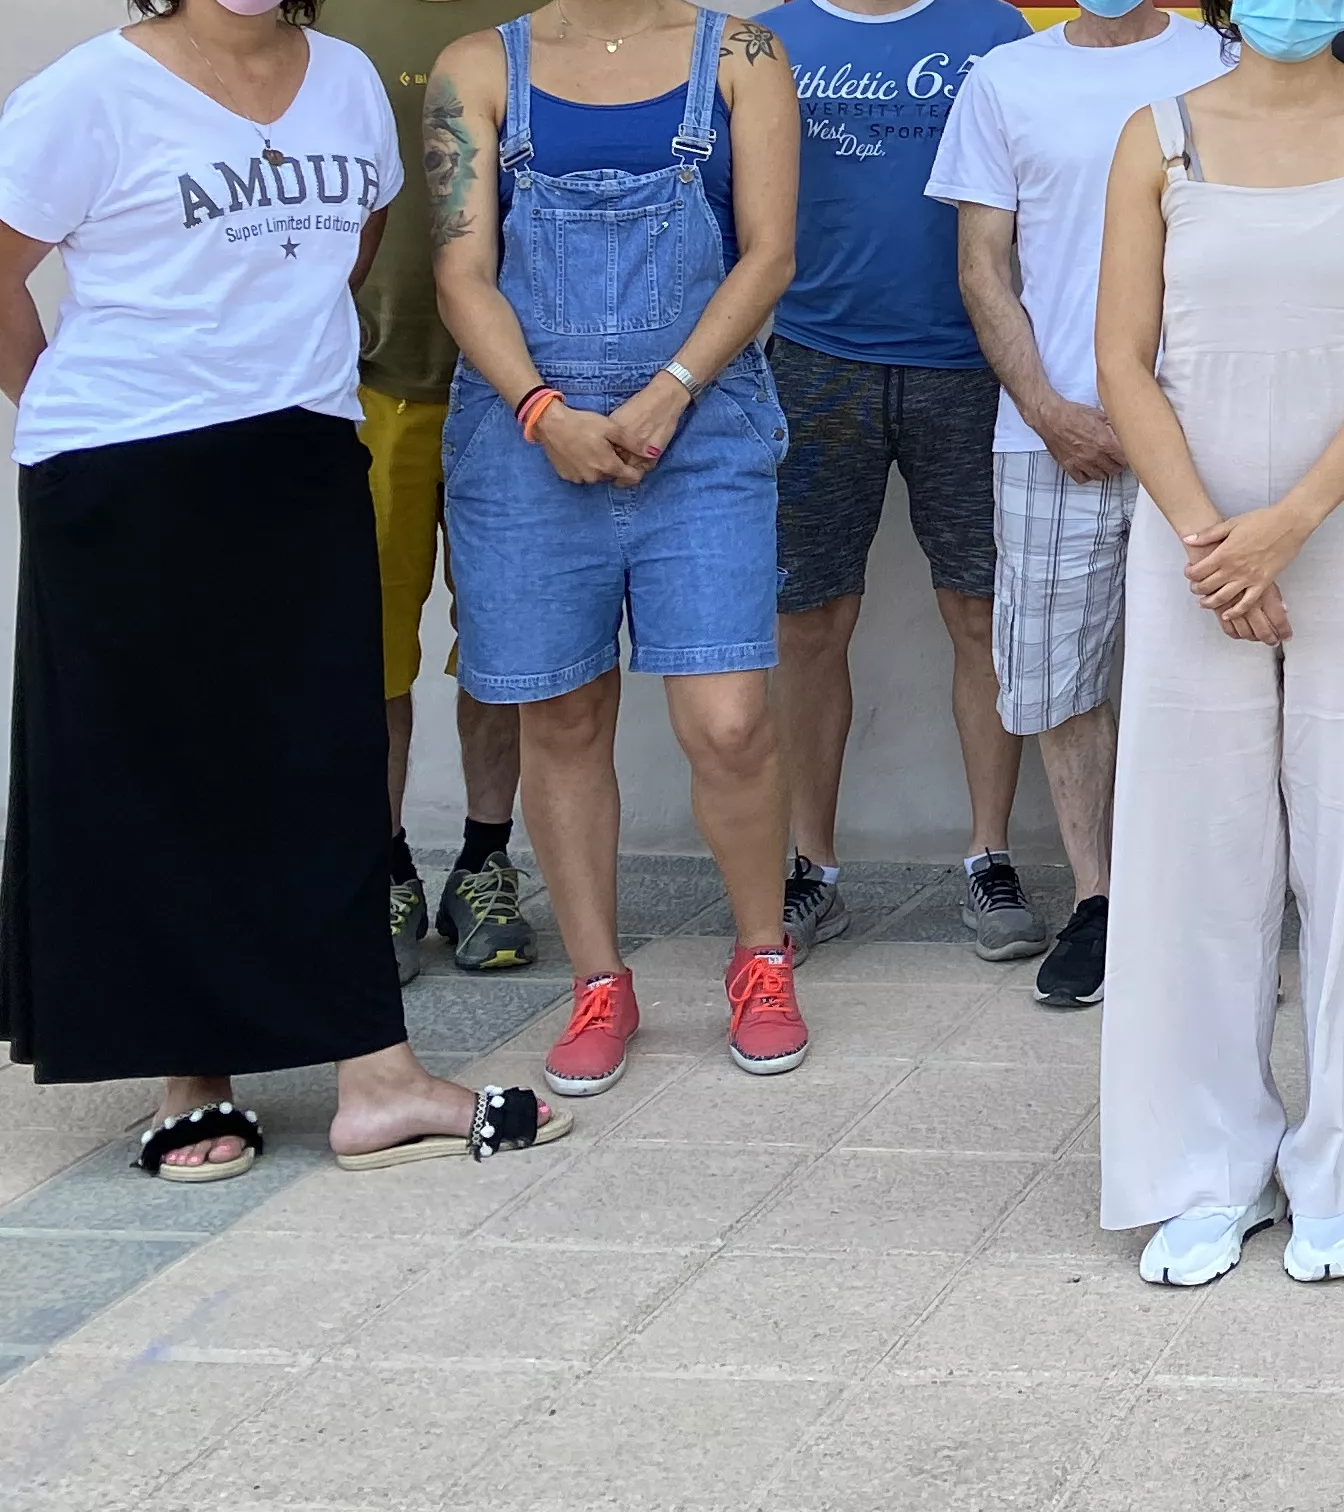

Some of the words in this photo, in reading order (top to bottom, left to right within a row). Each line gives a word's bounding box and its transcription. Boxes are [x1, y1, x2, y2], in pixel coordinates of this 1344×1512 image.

[806, 118, 846, 139] West
[868, 123, 944, 139] SPORT
[178, 154, 380, 229] AMOUR
[225, 220, 263, 242] Super
[266, 215, 311, 233] Limited
[316, 215, 359, 233] Edition
